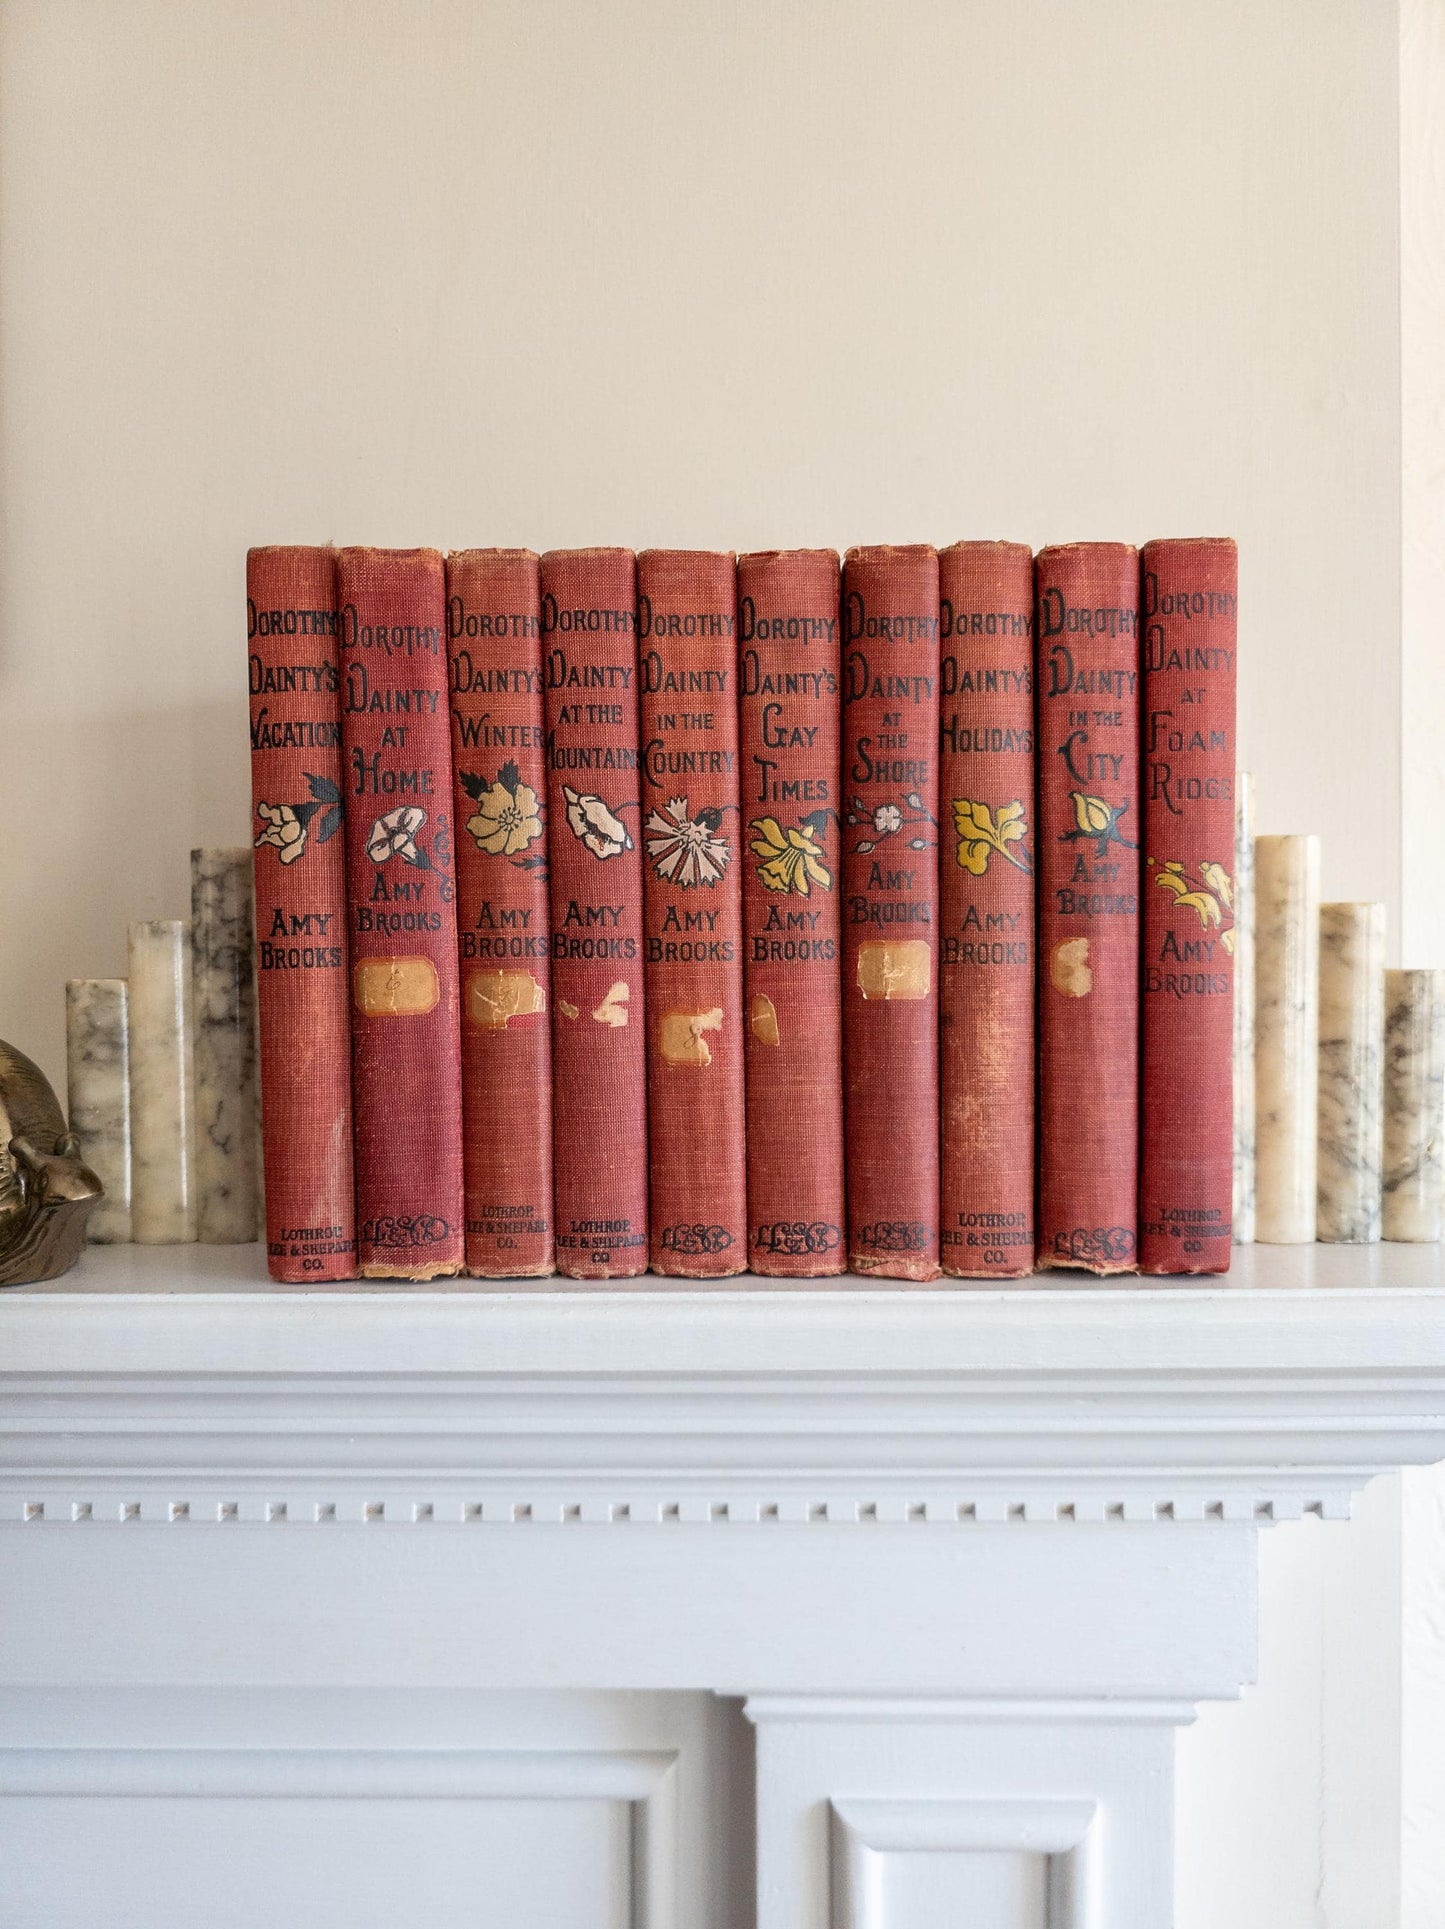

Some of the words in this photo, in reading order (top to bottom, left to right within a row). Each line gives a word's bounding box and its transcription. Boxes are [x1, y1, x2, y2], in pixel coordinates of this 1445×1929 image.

[1144, 572, 1237, 619] DOROTHY
[247, 598, 339, 641] DOROTHY
[540, 593, 638, 633] DOROTHY
[639, 596, 734, 639] DOROTHY
[740, 596, 836, 645] DOROTHY
[844, 591, 939, 645] DOROTHY
[940, 599, 1032, 638] DOROTHY
[1042, 588, 1137, 638] DOROTHY
[340, 604, 441, 656] DOROTHY
[1145, 624, 1233, 672] DAINTY
[249, 655, 340, 695] DAINTY'S
[450, 650, 545, 694] DAINTY'S
[547, 650, 632, 689] DAINTY
[642, 651, 728, 694] DAINTY
[742, 650, 838, 699] DAINTY'S
[845, 652, 936, 704] DAINTY
[940, 656, 1032, 695] DAINTY'S
[1048, 645, 1136, 699] DAINTY
[344, 662, 441, 714] DAINTY
[1181, 689, 1206, 704] AT
[250, 707, 343, 750] VACATION
[453, 710, 544, 748] WINTER
[557, 705, 582, 725] AT
[585, 704, 622, 724] THE
[657, 714, 676, 730] IN
[682, 713, 714, 730] THE
[762, 703, 818, 749] GAY
[881, 713, 902, 727] AT
[1069, 711, 1087, 726] IN
[1093, 711, 1122, 726] THE
[381, 727, 409, 748] AT
[877, 734, 908, 749] THE
[939, 714, 1033, 753] HOLIDAYS
[1146, 710, 1226, 753] FOAM
[352, 746, 434, 794] HOME
[643, 738, 735, 789] COUNTRY
[851, 737, 928, 789] SHORE
[1058, 731, 1123, 785] CITY
[753, 755, 829, 802] TIMES
[1149, 763, 1232, 815] RIDGE
[867, 861, 916, 891] AMY
[1069, 854, 1120, 883] AMY
[369, 872, 426, 901] AMY
[476, 901, 532, 929] AMY
[563, 901, 624, 927] AMY
[662, 905, 720, 931] AMY
[763, 905, 821, 931] AMY
[848, 896, 931, 930] BROOKS
[961, 905, 1021, 932] AMY
[1056, 888, 1136, 919] BROOKS
[269, 908, 333, 937] AMY
[356, 907, 442, 938] BROOKS
[260, 942, 342, 970] BROOKS
[463, 932, 549, 958] BROOKS
[553, 934, 637, 959] BROOKS
[647, 937, 735, 962] BROOKS
[752, 937, 836, 961] BROOKS
[942, 938, 1027, 965] BROOKS
[1159, 930, 1216, 962] AMY
[1145, 967, 1229, 999] BROOKS
[290, 1243, 299, 1256] &
[580, 1236, 589, 1248] &
[942, 1231, 962, 1246] EE
[967, 1233, 979, 1246] &
[303, 1259, 324, 1270] CO.
[984, 1250, 1008, 1264] CO.
